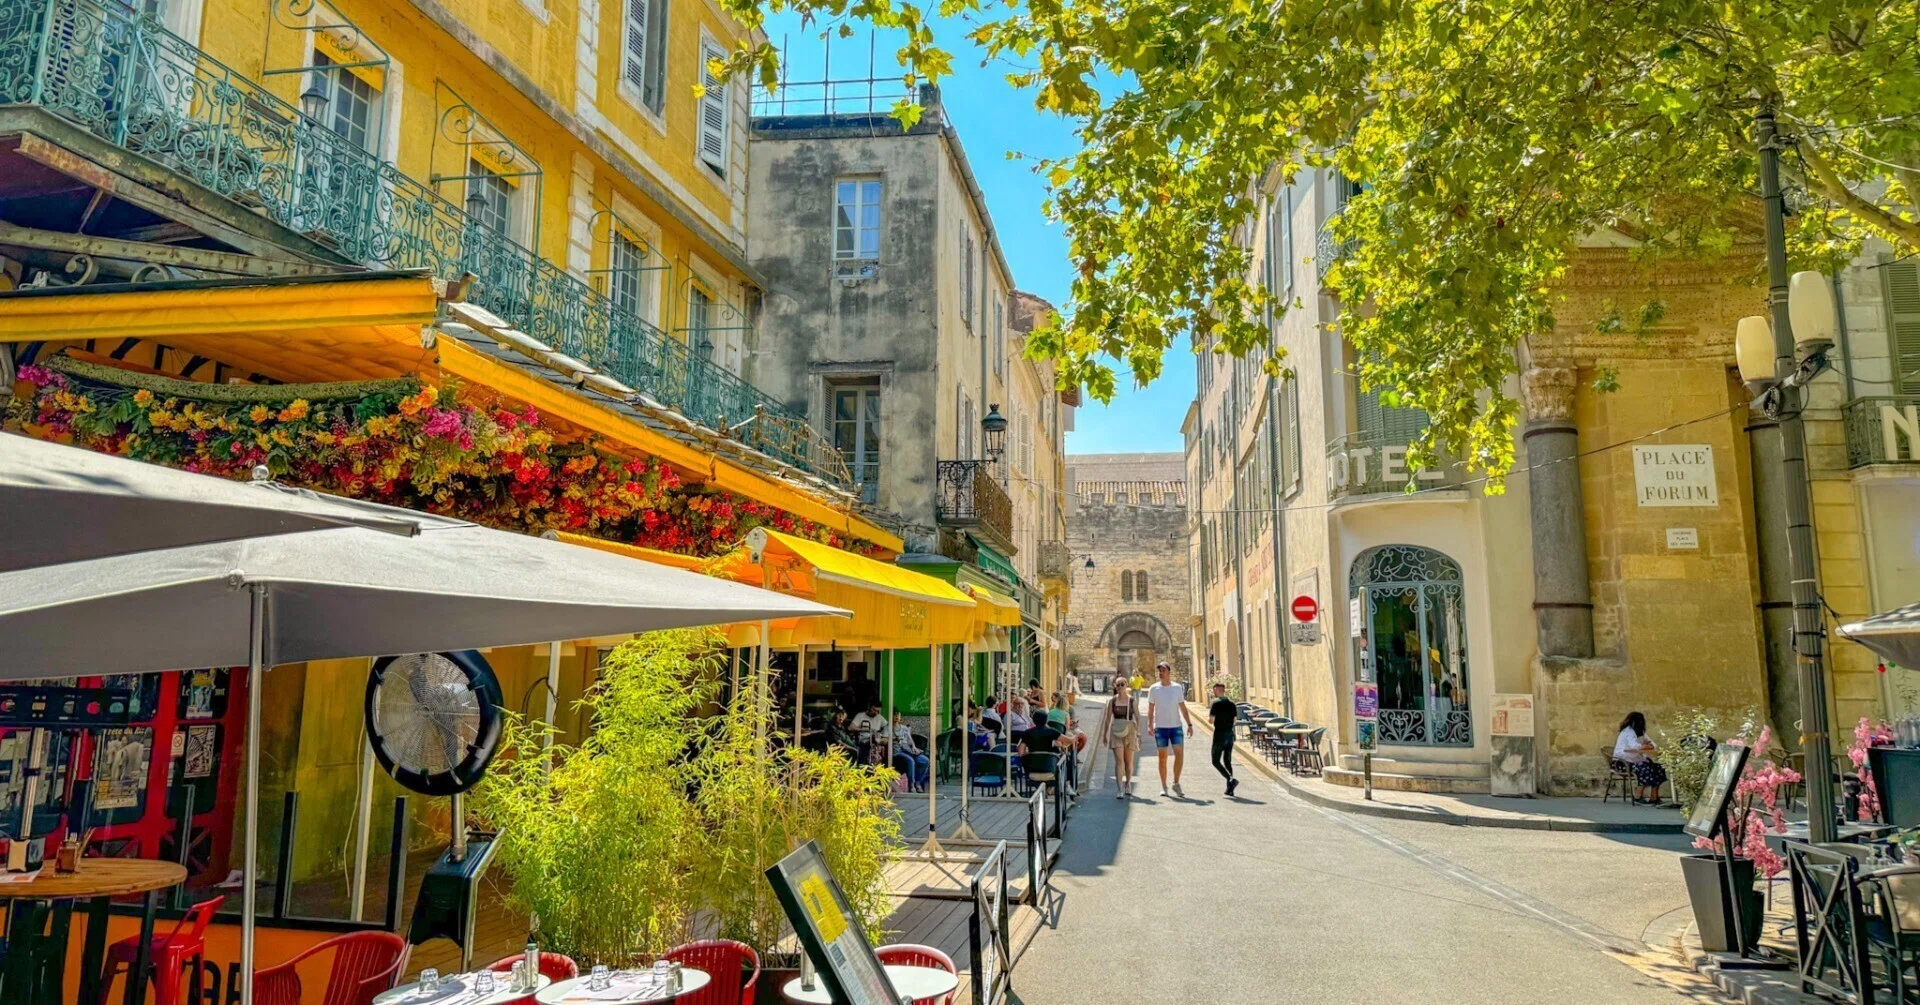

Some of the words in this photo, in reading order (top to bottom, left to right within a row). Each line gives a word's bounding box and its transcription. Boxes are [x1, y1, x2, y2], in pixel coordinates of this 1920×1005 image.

[1881, 405, 1920, 461] N
[1642, 451, 1706, 465] PLACE
[1666, 471, 1684, 480] DU
[1645, 486, 1709, 500] FORUM
